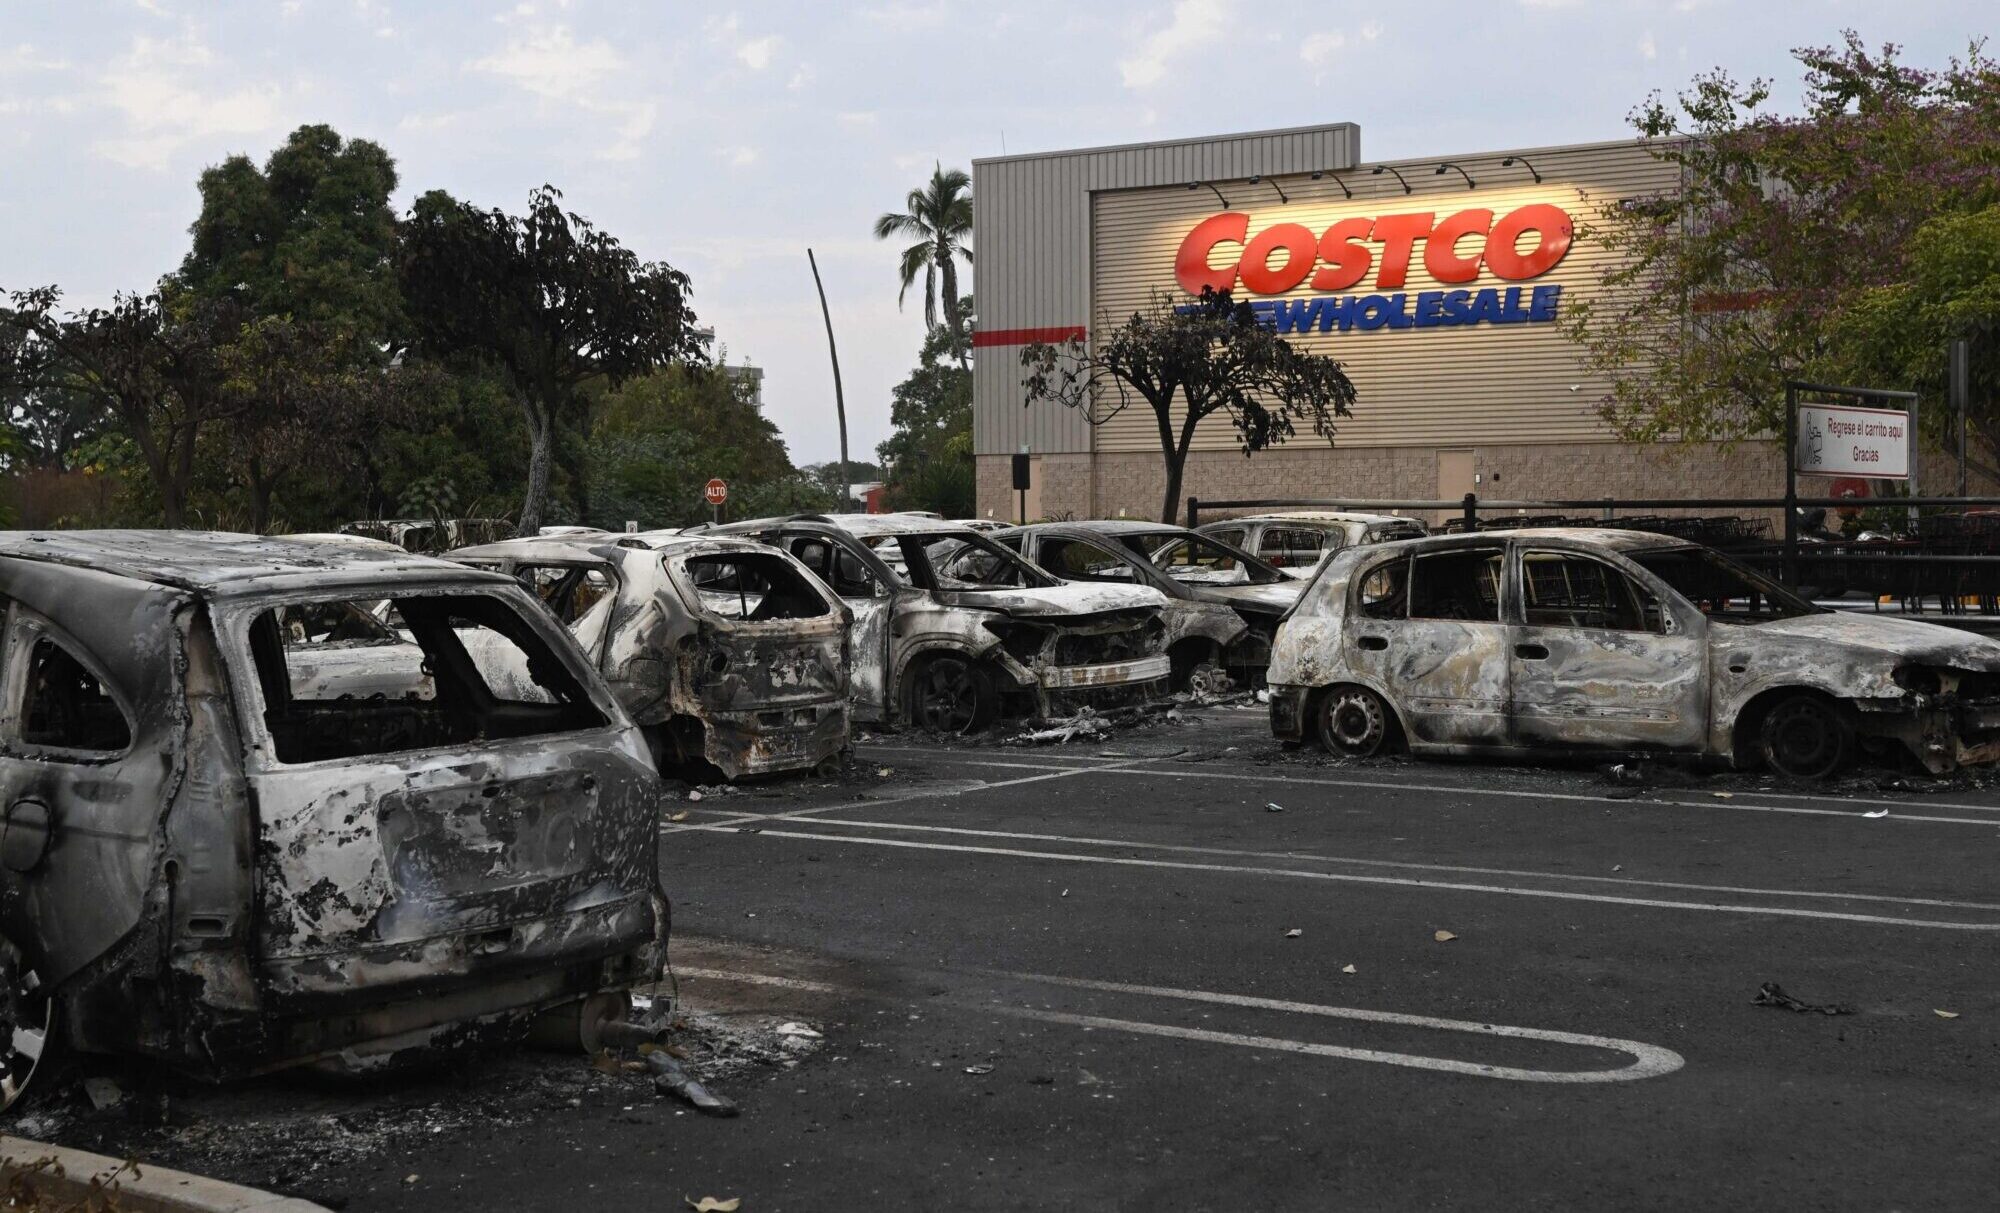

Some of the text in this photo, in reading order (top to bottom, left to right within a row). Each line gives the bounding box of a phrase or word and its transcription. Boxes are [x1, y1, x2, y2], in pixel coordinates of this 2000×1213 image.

[1174, 203, 1574, 297] COSTCO
[1273, 285, 1561, 333] WHOLESALE
[1828, 417, 1904, 441] Regrese el carrito aquí
[1853, 446, 1879, 462] Gracias
[707, 486, 726, 497] ALTO
